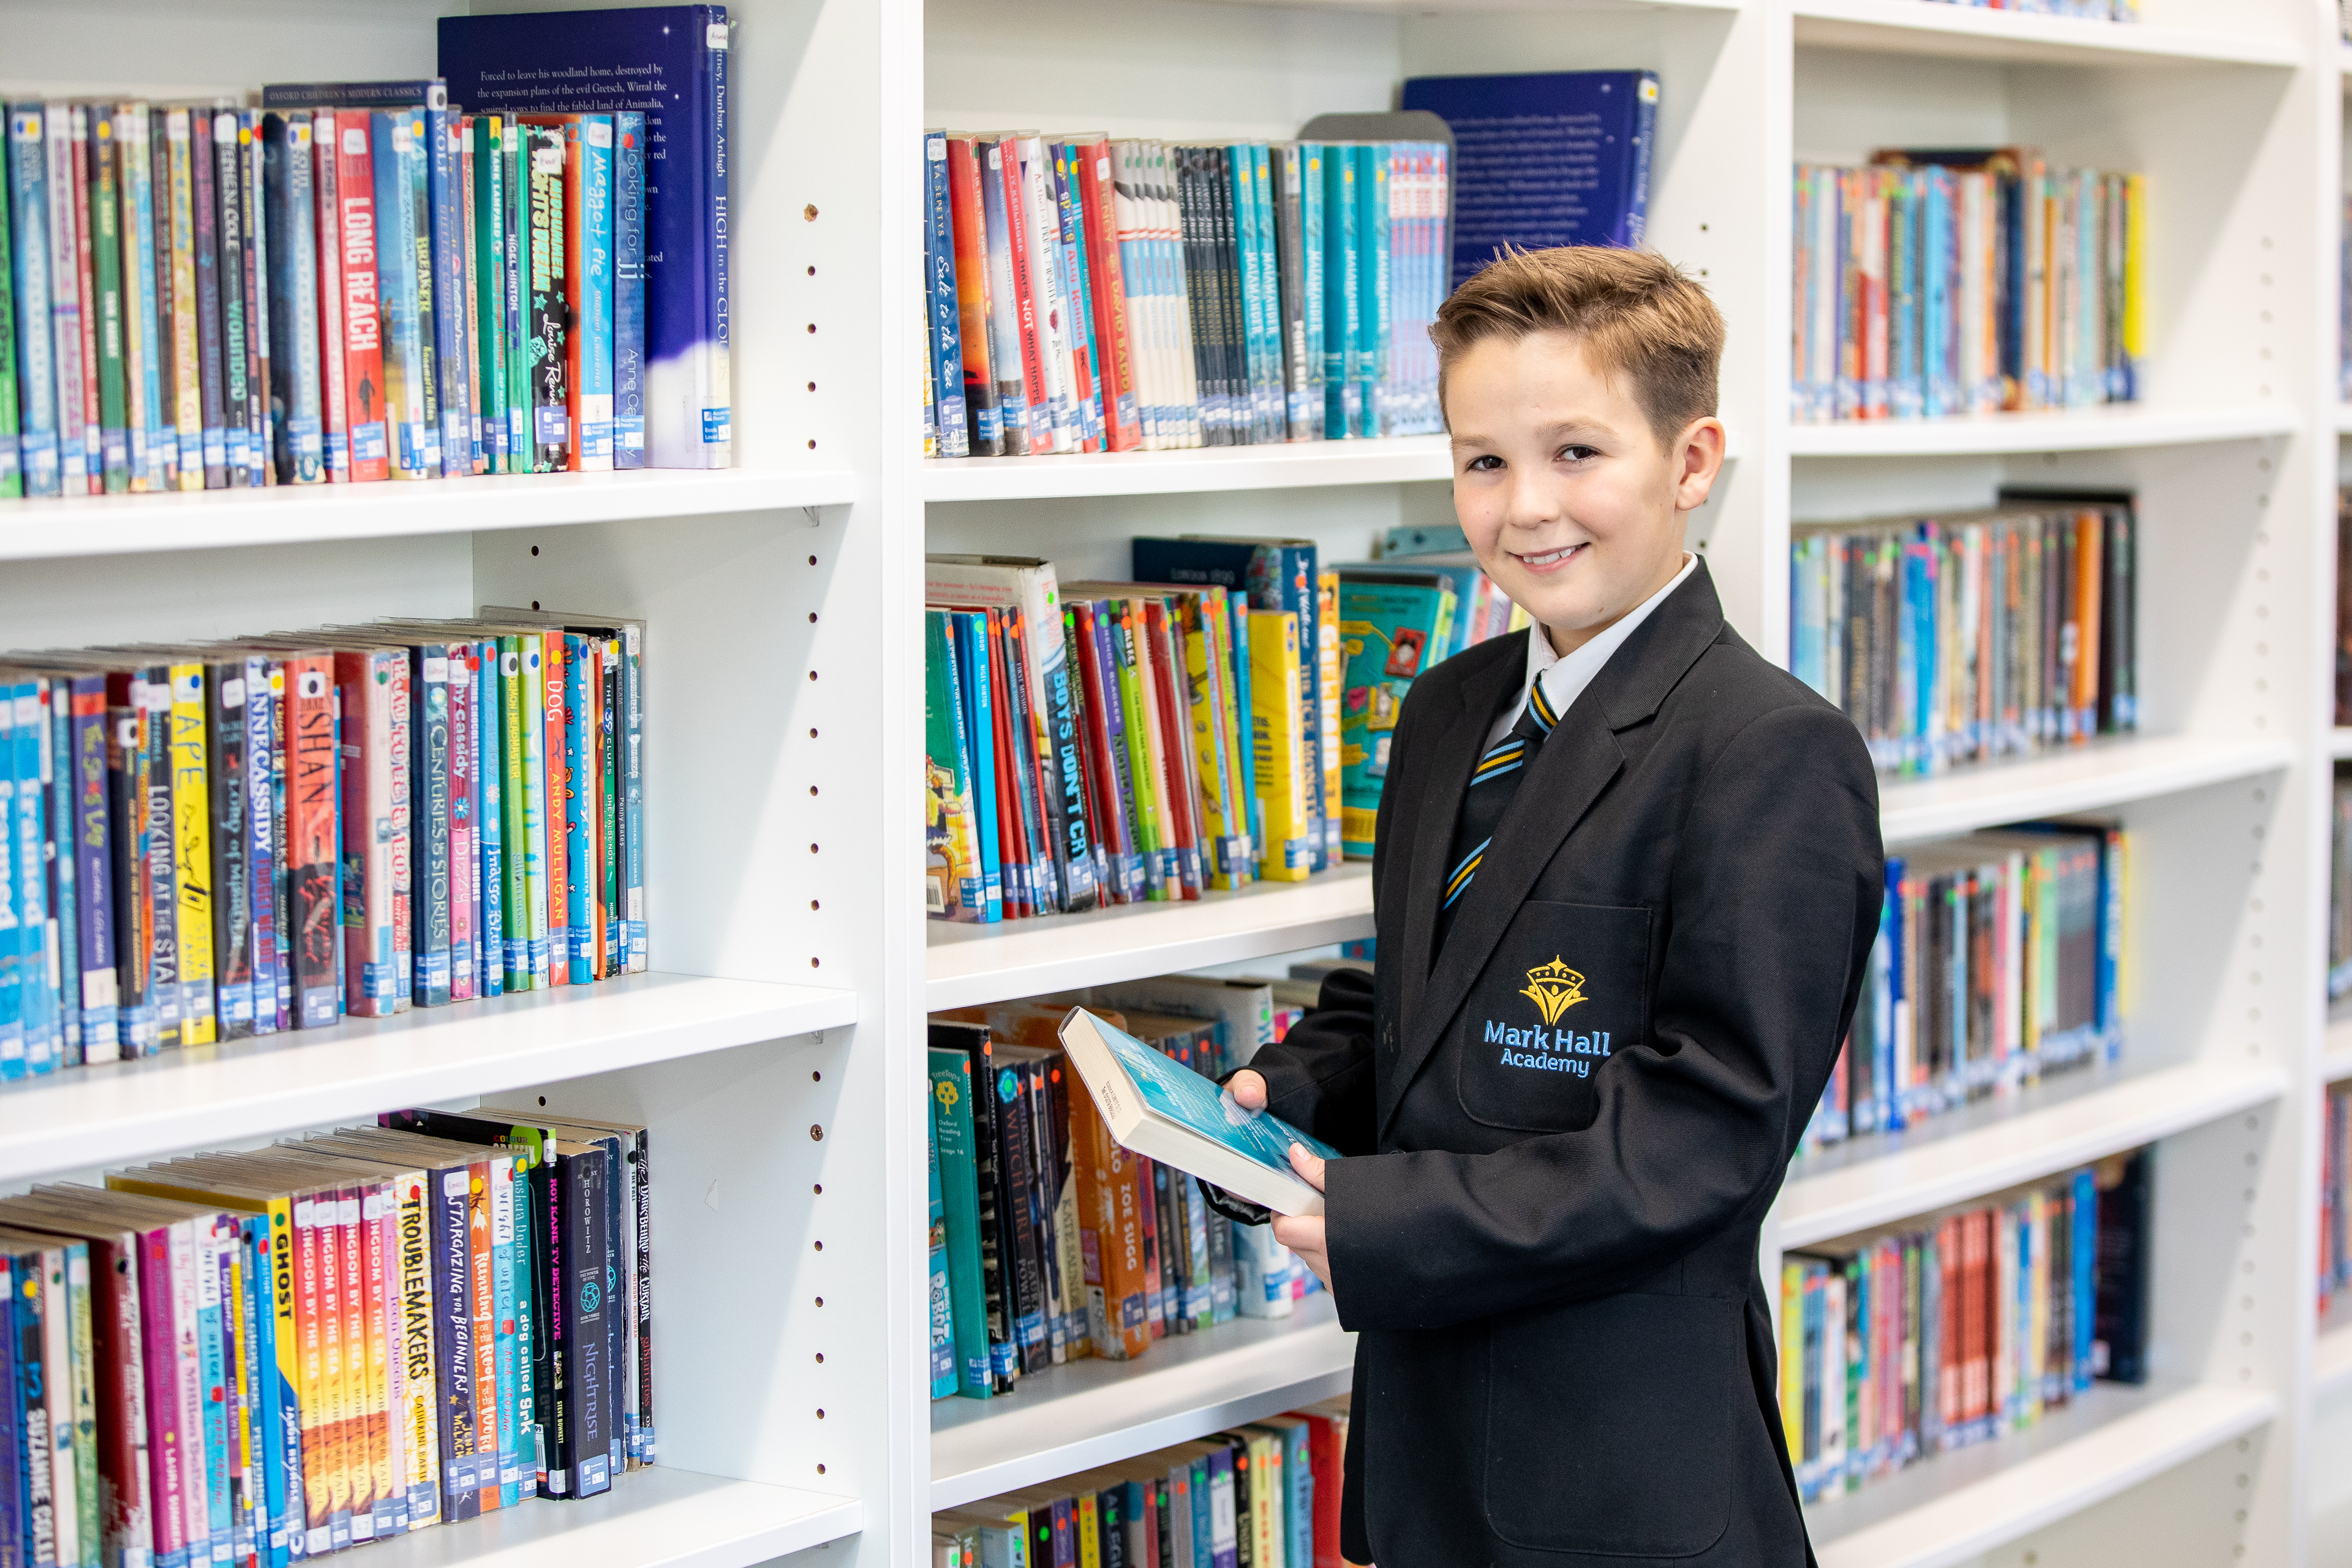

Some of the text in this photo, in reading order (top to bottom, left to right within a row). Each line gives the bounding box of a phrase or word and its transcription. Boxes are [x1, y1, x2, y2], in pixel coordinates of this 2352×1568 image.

[478, 80, 667, 100] the expansion plans of the evil Gretsch, Wirral the
[481, 63, 663, 81] Forced to leave his woodland home, destroyed by
[530, 97, 664, 113] to find the fabled land of Animalia,
[435, 115, 448, 178] WOLF
[654, 133, 666, 143] the
[654, 149, 666, 160] red
[624, 149, 639, 221] looking
[715, 85, 727, 293] Dunbar, Ardagh HIGH the
[934, 185, 945, 236] SEPETYS
[492, 186, 503, 238] LAMPARD
[531, 177, 565, 292] MIDSUMMER DREAM
[1059, 191, 1075, 242] sparks
[627, 228, 639, 255] for
[1041, 226, 1057, 307] PRIME MINISTER
[344, 197, 378, 351] LONG REACH
[416, 235, 431, 313] BREAKER
[508, 235, 519, 311] NIGEL HINTON
[589, 151, 607, 389] Maggot Pie Lawrence
[1018, 258, 1030, 299] THAT'S
[940, 304, 951, 320] to
[1021, 299, 1034, 330] NOT
[1110, 280, 1125, 333] DAVID
[544, 314, 562, 360] Louise
[940, 326, 956, 352] the
[1025, 330, 1039, 364] WHAT
[625, 348, 639, 391] Anne
[1016, 662, 1028, 715] FIRST MISSION
[510, 712, 521, 779] HEADMASTER
[603, 710, 614, 733] 39
[298, 710, 334, 806] SHAN
[1053, 671, 1074, 739] BOYS
[1068, 819, 1089, 864] CRY
[453, 709, 470, 903] cassidy Dizzy
[546, 680, 564, 920] DOG ANDY MULLIGAN
[148, 785, 172, 900] LOOKING AT
[429, 725, 449, 938] CENTURIES STORIES
[472, 862, 481, 902] BROOKS
[1484, 1020, 1611, 1057] Mark Hall
[1501, 1049, 1590, 1078] Academy
[932, 1069, 961, 1082] TreeTops
[494, 1134, 528, 1144] COLOUR
[938, 1127, 961, 1137] Reading
[549, 1178, 559, 1203] ROY
[1006, 1108, 1029, 1243] WITCH FIRE
[550, 1205, 559, 1245] KANE
[1061, 1199, 1074, 1235] KATE
[1120, 1182, 1137, 1271] ZOE SUGG
[551, 1247, 560, 1264] TV
[372, 1284, 385, 1333] BY THE
[448, 1197, 468, 1393] STARGAZING BEGINNERS
[473, 1253, 494, 1321] Running
[551, 1267, 562, 1340] DETECTIVE
[640, 1276, 651, 1324] CURTAIN
[930, 1271, 946, 1347] ROBOTS
[276, 1232, 300, 1445] GHOST JASON
[306, 1297, 318, 1348] BY THE
[325, 1294, 337, 1344] BY THE
[349, 1289, 361, 1339] BY THE
[401, 1199, 429, 1448] TROUBLEMAKERS CATHERINE
[515, 1224, 534, 1435] Doder dog called grk
[582, 1343, 598, 1442] NIGHTRISE
